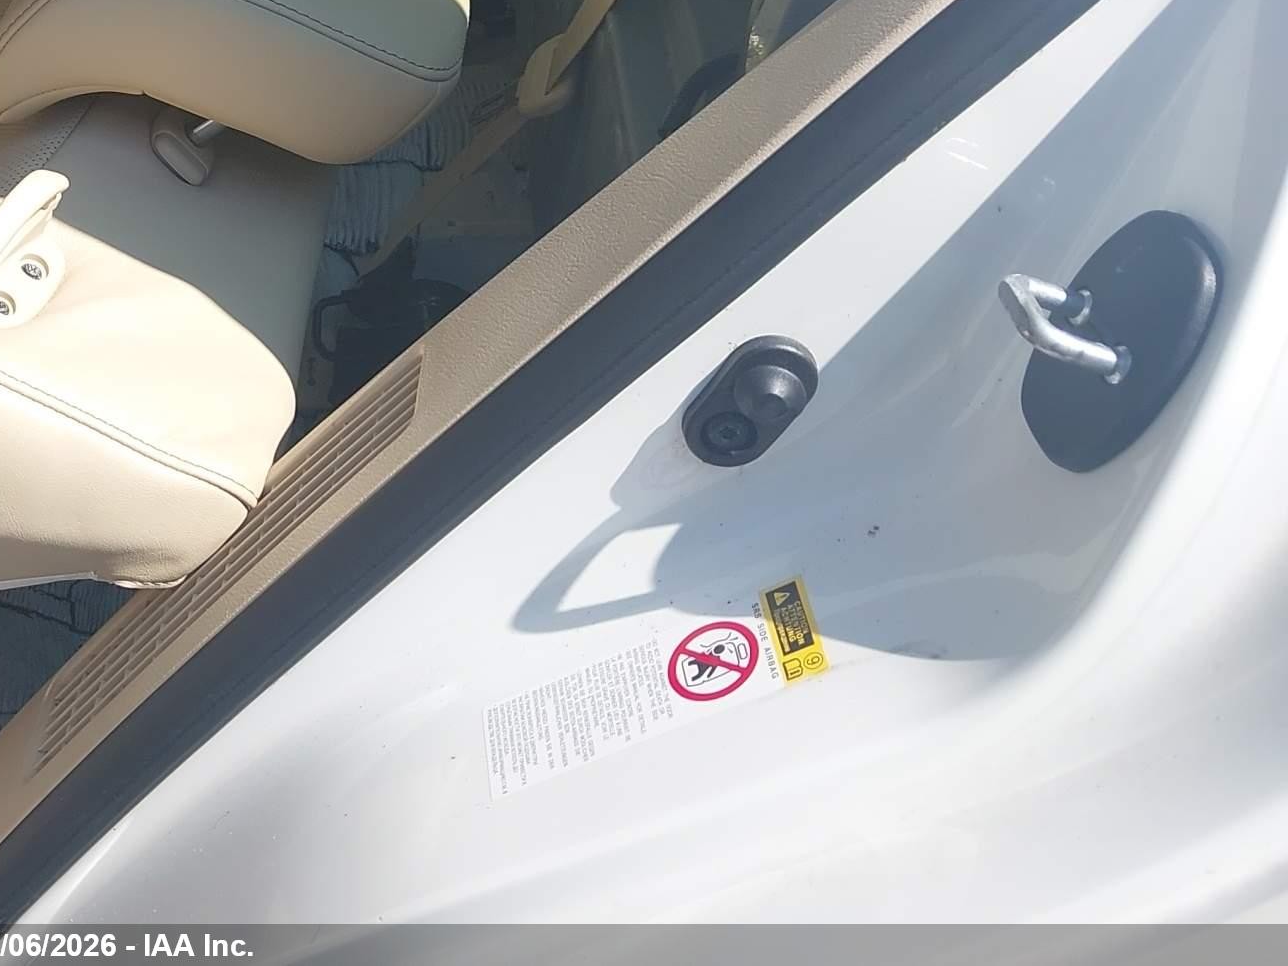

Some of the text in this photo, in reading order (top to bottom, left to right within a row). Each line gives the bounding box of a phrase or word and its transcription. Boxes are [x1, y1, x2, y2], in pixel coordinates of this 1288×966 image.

[781, 607, 797, 643] ACHTUNG
[787, 604, 805, 645] ATTENTION
[794, 601, 809, 634] CAUTION
[751, 602, 779, 679] SRS SIDE AIRBAG
